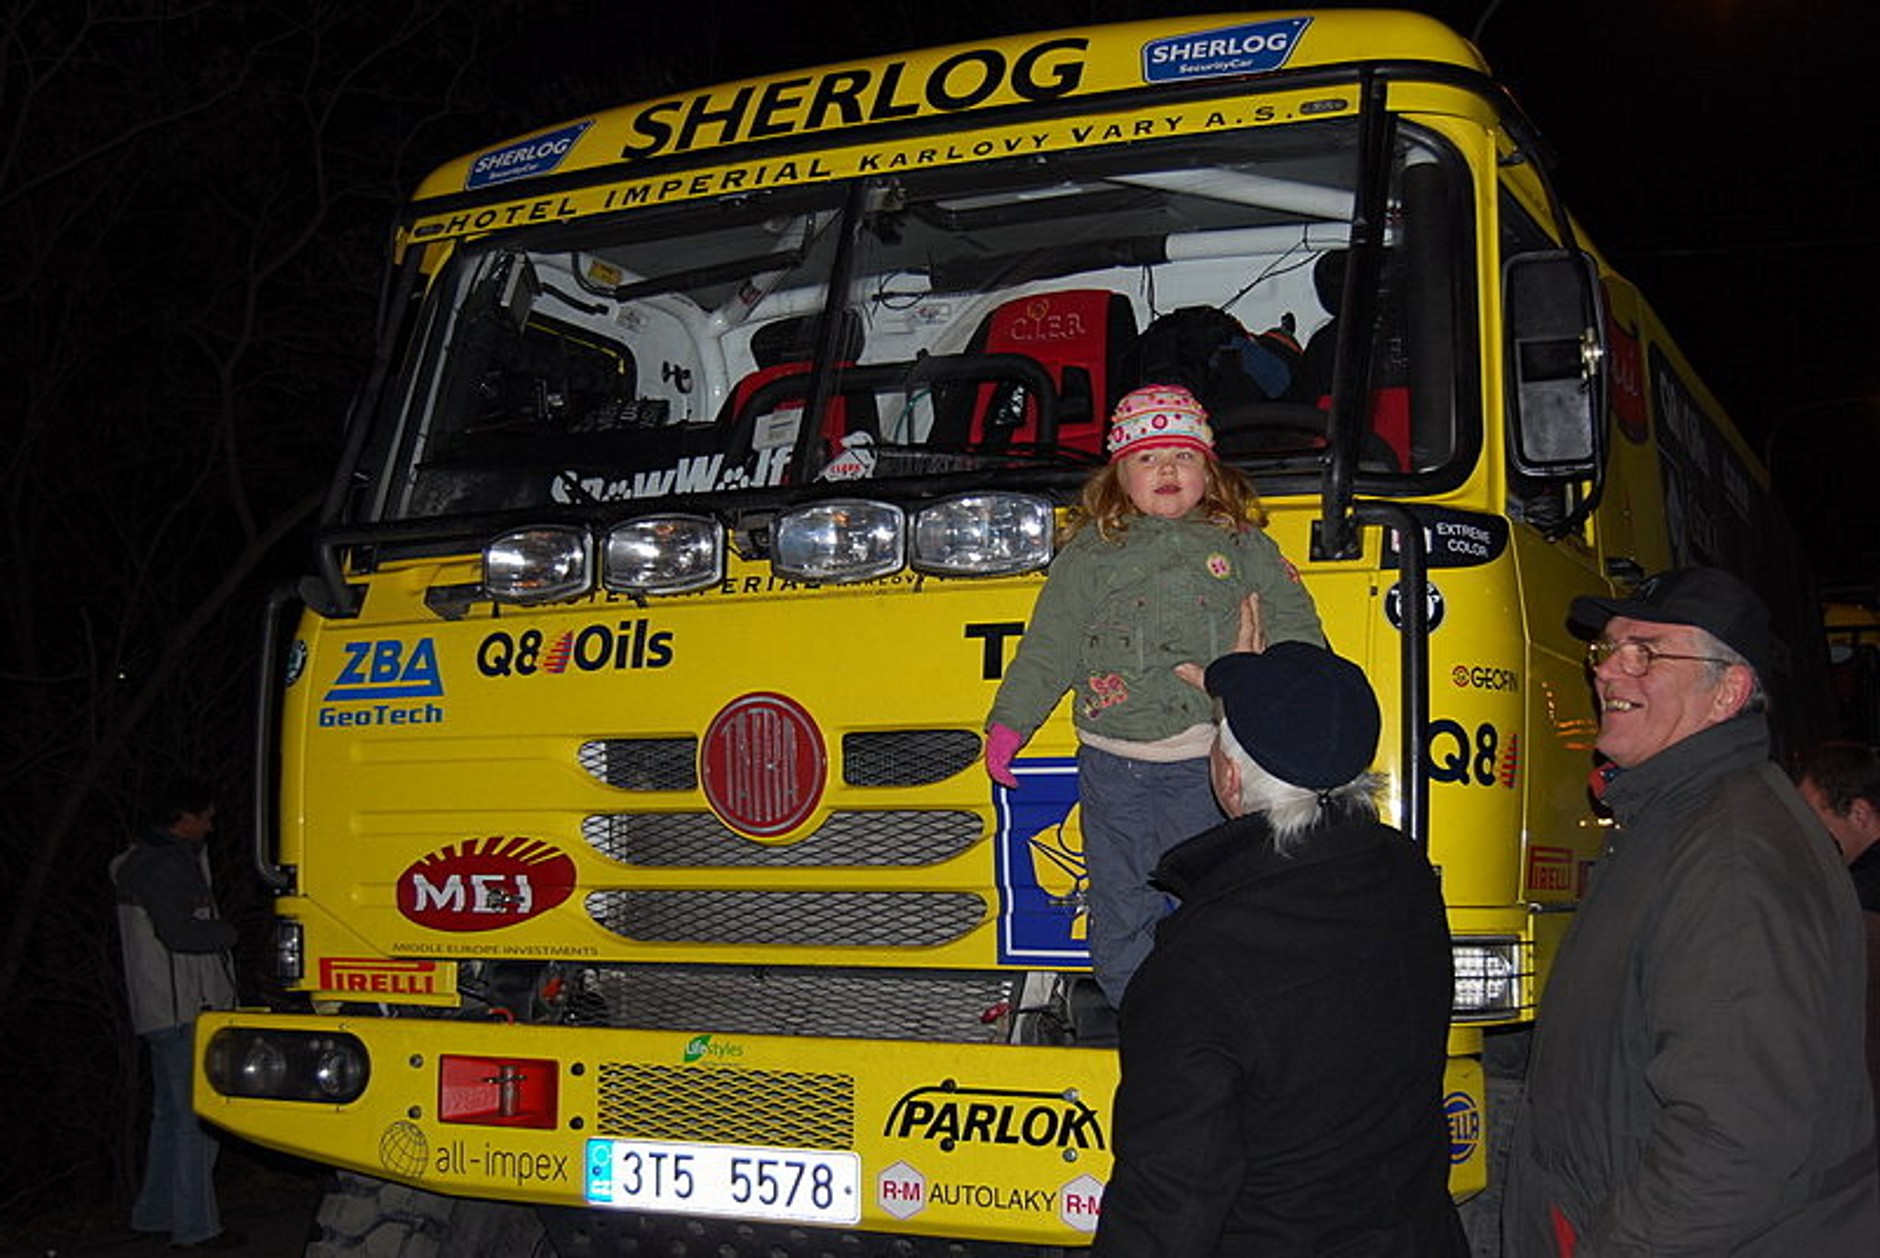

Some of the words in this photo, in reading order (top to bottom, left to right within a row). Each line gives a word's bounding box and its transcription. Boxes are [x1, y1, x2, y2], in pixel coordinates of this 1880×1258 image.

[1152, 33, 1288, 63] SHERLOG
[621, 38, 1089, 160] SHERLOG
[446, 197, 576, 234] HOTEL
[604, 158, 831, 208] IMPERIAL
[858, 134, 1051, 172] KARLOVY
[1070, 115, 1183, 144] VARY
[1205, 105, 1293, 129] A.S.
[474, 137, 571, 173] SHERLOG
[1436, 522, 1491, 544] EXTREME
[1447, 539, 1488, 558] COLOR
[334, 638, 443, 687] ZBA
[477, 629, 543, 677] Q8
[574, 619, 674, 671] Oils
[319, 704, 443, 728] GeoTech
[1428, 719, 1498, 787] Q8
[393, 943, 442, 953] MIDDLE
[449, 944, 497, 955] EUROPE
[502, 945, 598, 957] INVESTMENTS
[319, 957, 436, 994] PIRELLI
[898, 1101, 1098, 1149] PARLOK
[435, 1142, 568, 1185] all-impex
[622, 1151, 695, 1199] 3T5
[731, 1157, 834, 1210] 5578
[883, 1181, 920, 1201] R-M
[929, 1183, 1056, 1211] AUTOLAKY
